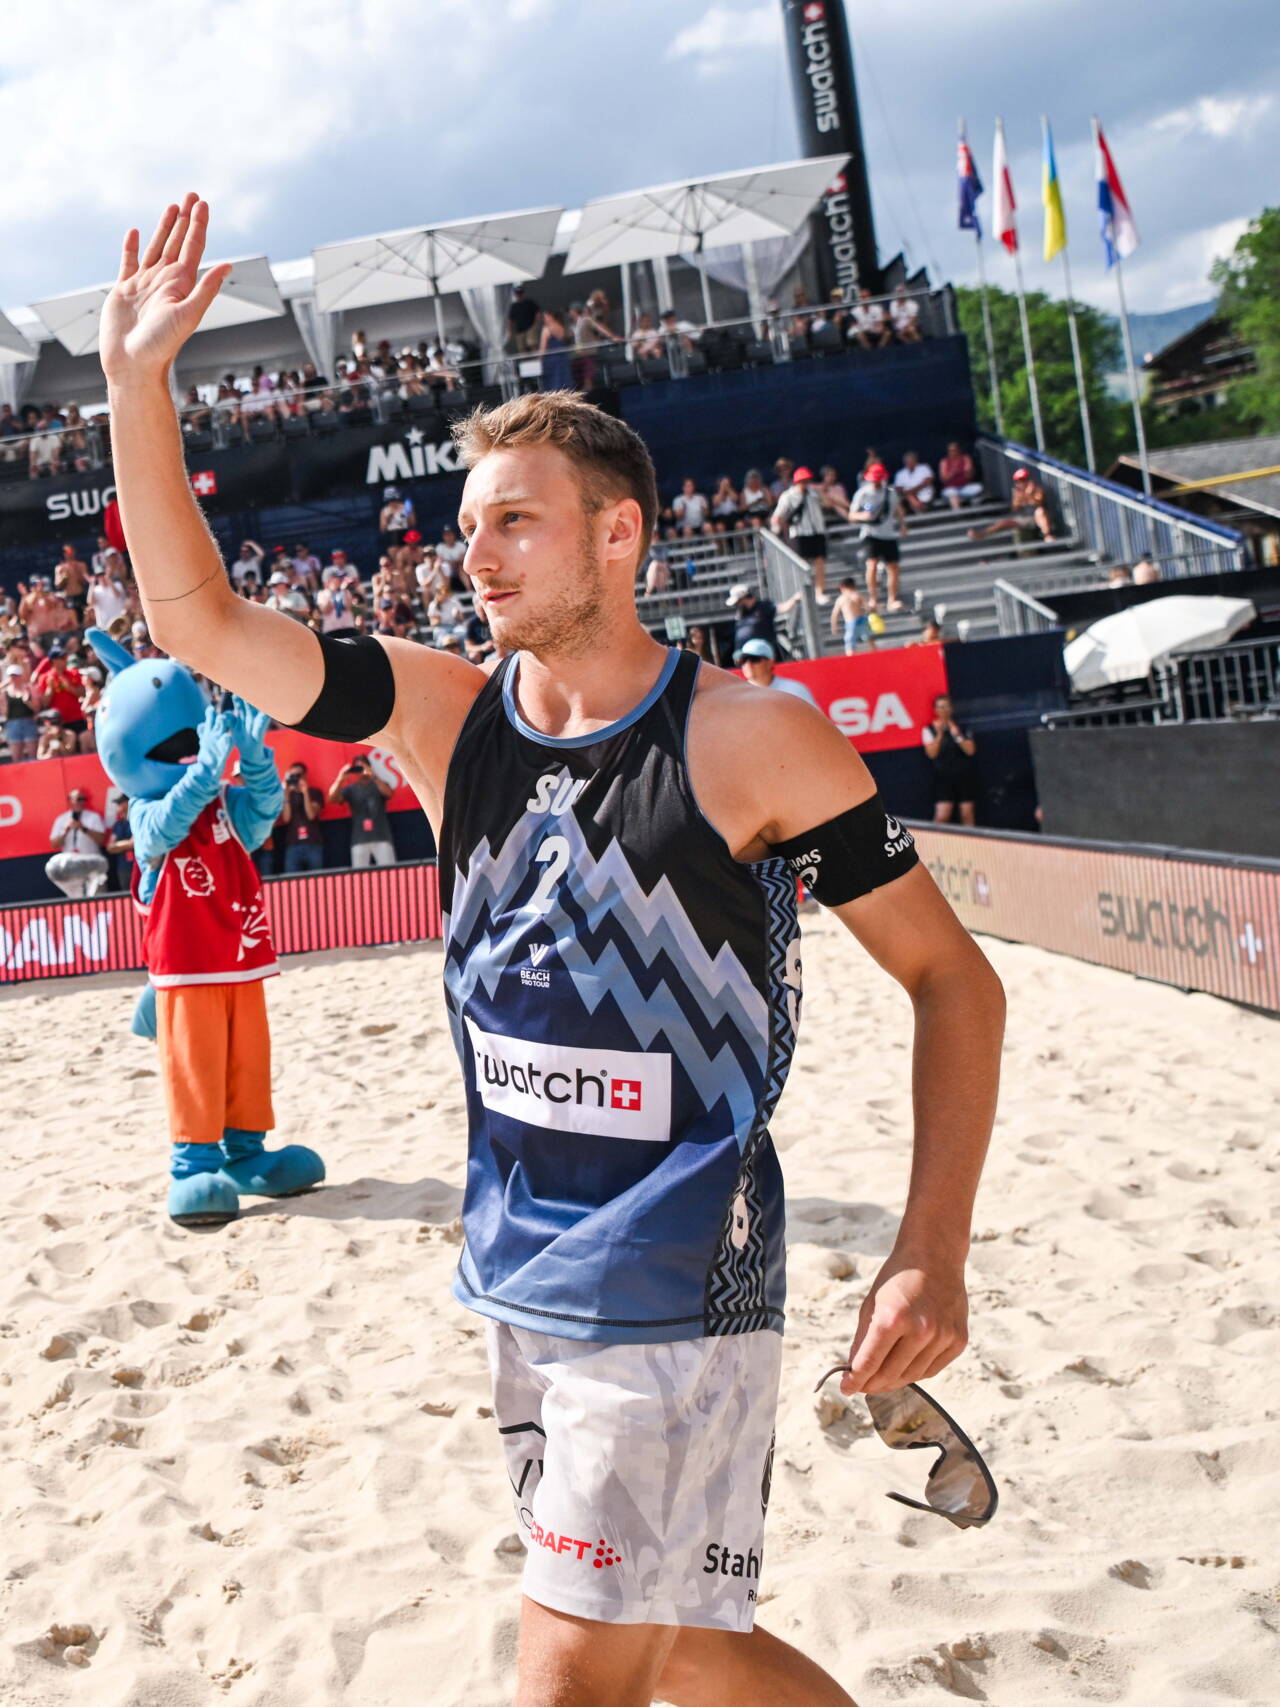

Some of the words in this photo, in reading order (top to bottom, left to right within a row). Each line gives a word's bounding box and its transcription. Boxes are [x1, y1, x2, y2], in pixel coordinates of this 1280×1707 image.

[802, 20, 840, 133] swatch
[824, 193, 860, 304] swatch
[829, 692, 914, 737] SA
[523, 835, 570, 914] 2
[520, 969, 551, 982] BEACH
[477, 1051, 608, 1108] watch
